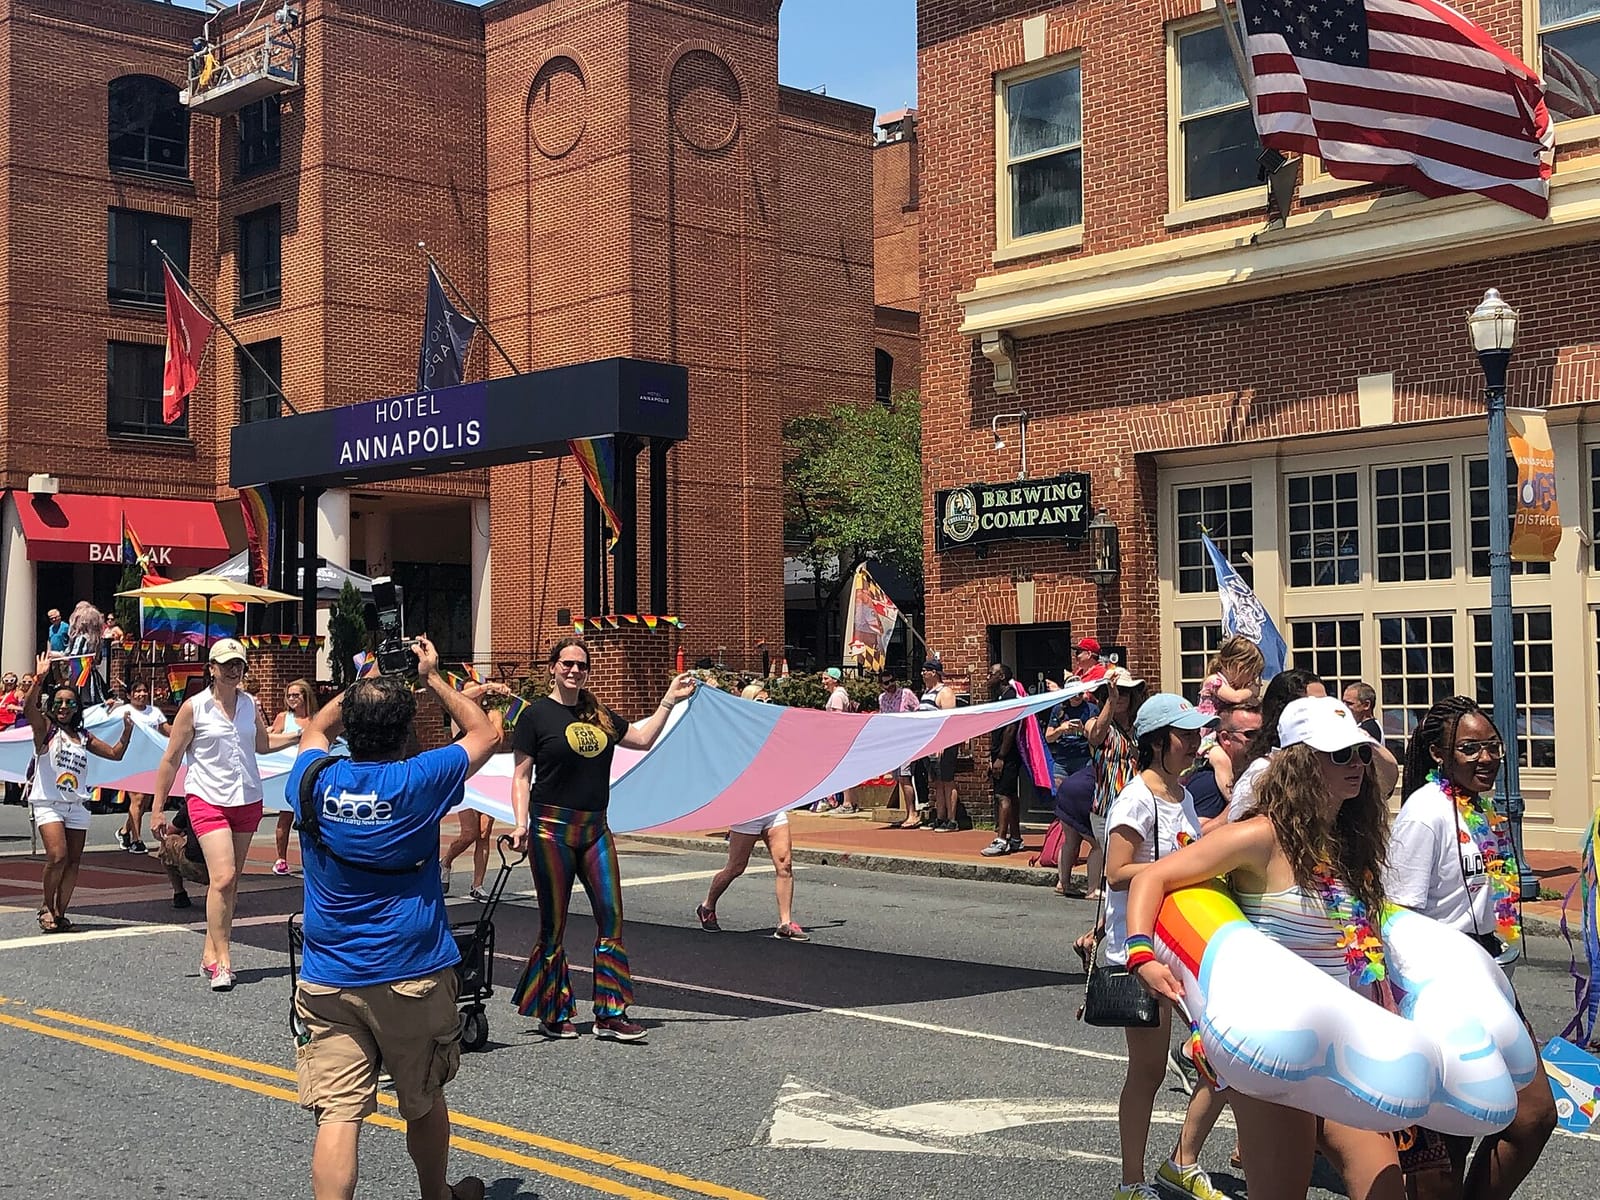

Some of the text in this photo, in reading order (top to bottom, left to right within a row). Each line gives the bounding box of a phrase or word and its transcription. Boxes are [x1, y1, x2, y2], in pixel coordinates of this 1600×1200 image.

[375, 394, 441, 423] HOTEL
[639, 395, 670, 404] ANNAPOLIS
[339, 420, 480, 465] ANNAPOLIS
[1518, 457, 1555, 468] ANNAPOLIS
[981, 481, 1083, 508] BREWING
[980, 504, 1084, 530] COMPANY
[1517, 514, 1561, 526] DISTRICT
[89, 543, 172, 565] BAAK
[574, 730, 596, 738] FOR
[578, 744, 600, 752] KIDS
[323, 785, 392, 820] blade
